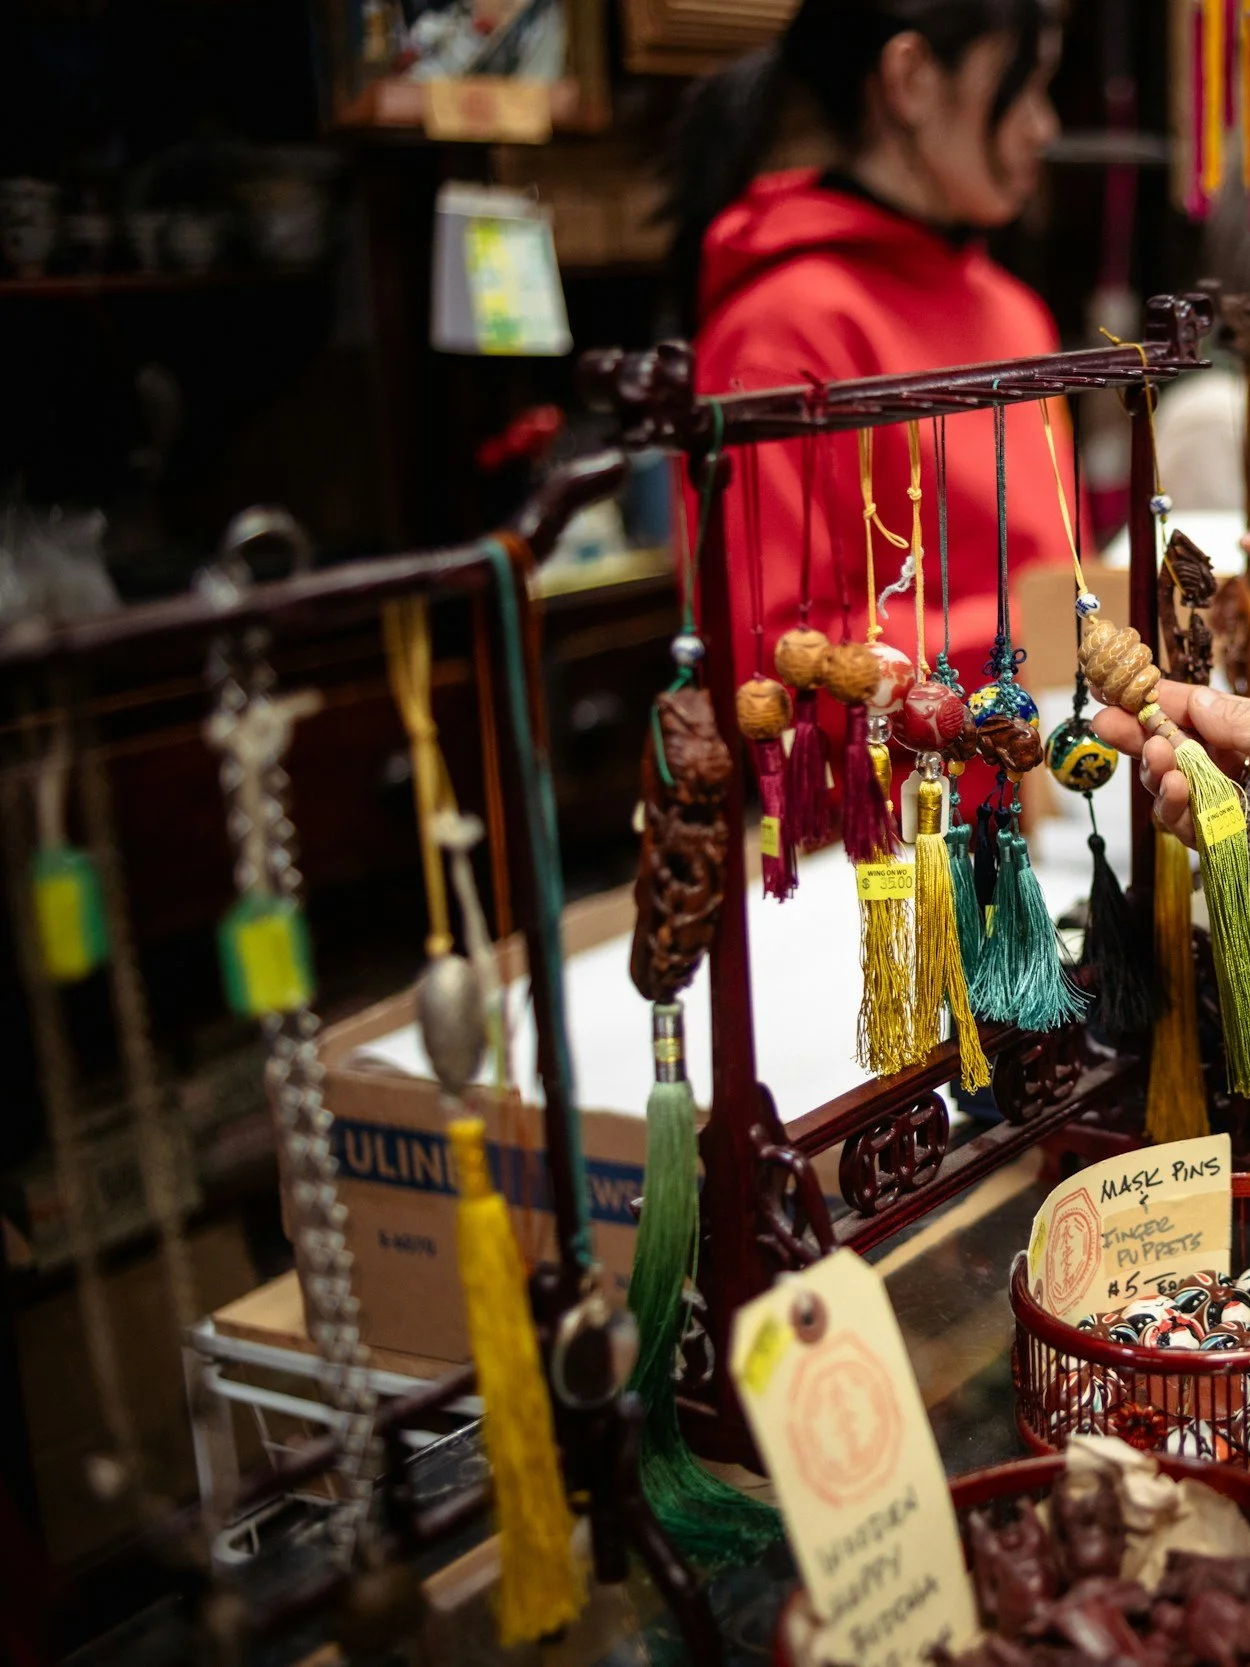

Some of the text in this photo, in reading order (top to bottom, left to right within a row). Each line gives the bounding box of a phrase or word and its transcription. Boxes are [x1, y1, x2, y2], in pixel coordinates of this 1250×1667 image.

[1101, 1157, 1220, 1203] MASK PINS
[1101, 1216, 1174, 1249] FINGER
[1117, 1231, 1203, 1268] PUPPETS
